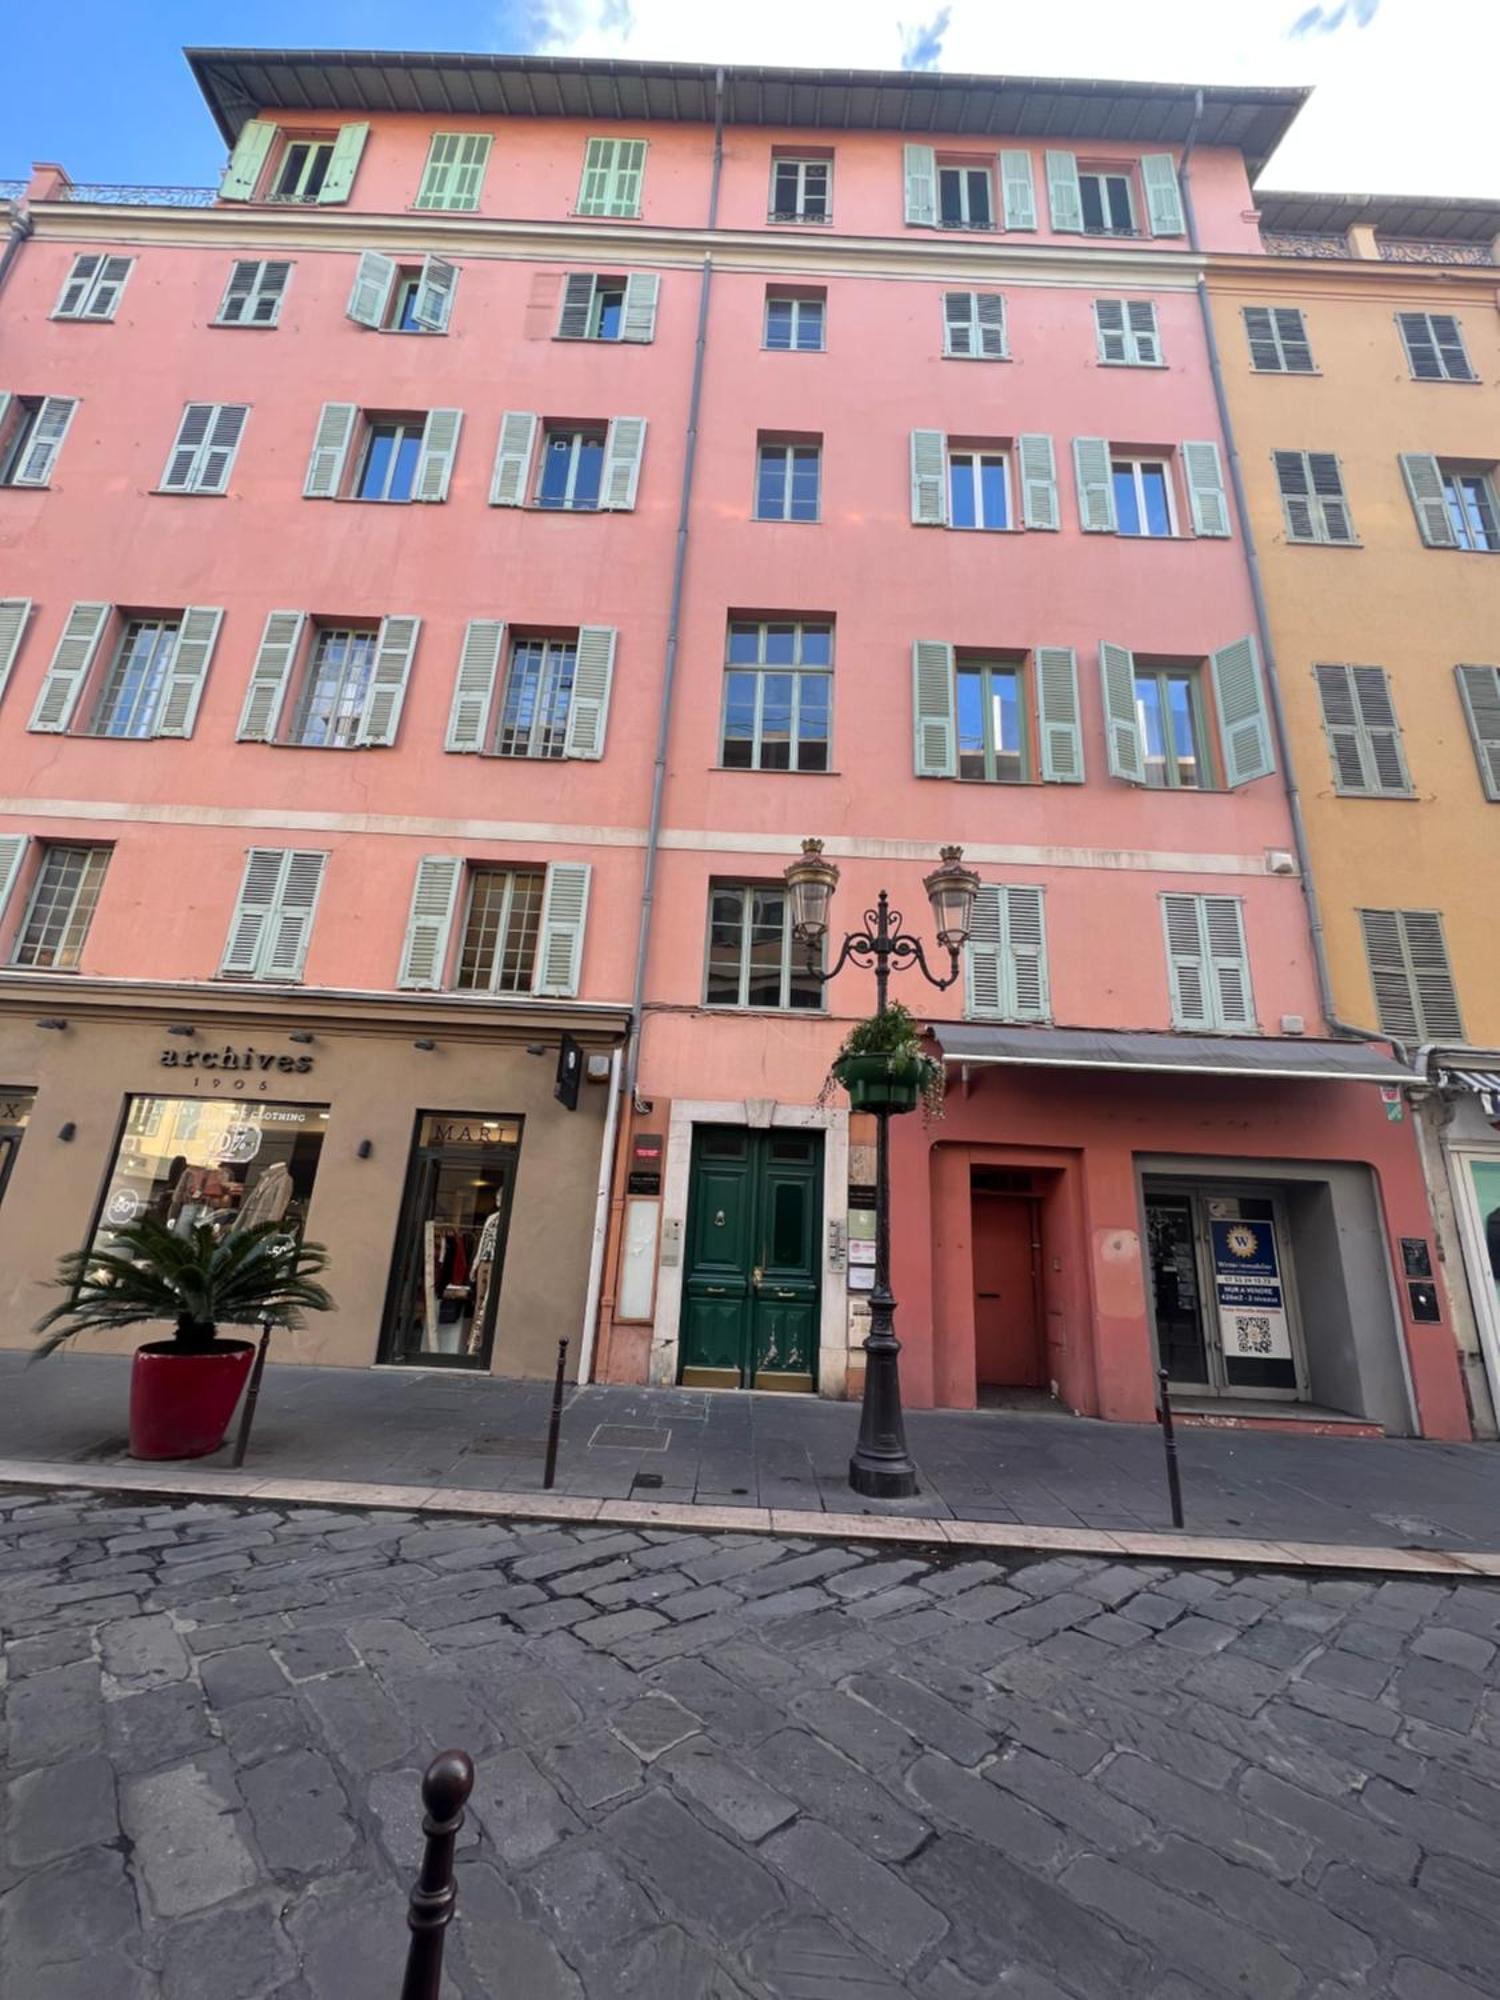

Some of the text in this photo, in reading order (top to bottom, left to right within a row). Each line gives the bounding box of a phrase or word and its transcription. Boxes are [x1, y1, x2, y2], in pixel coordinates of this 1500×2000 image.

[160, 1045, 314, 1074] archives
[193, 1077, 268, 1091] 1906
[251, 1109, 306, 1122] CLOTHING
[1234, 1236, 1249, 1247] W
